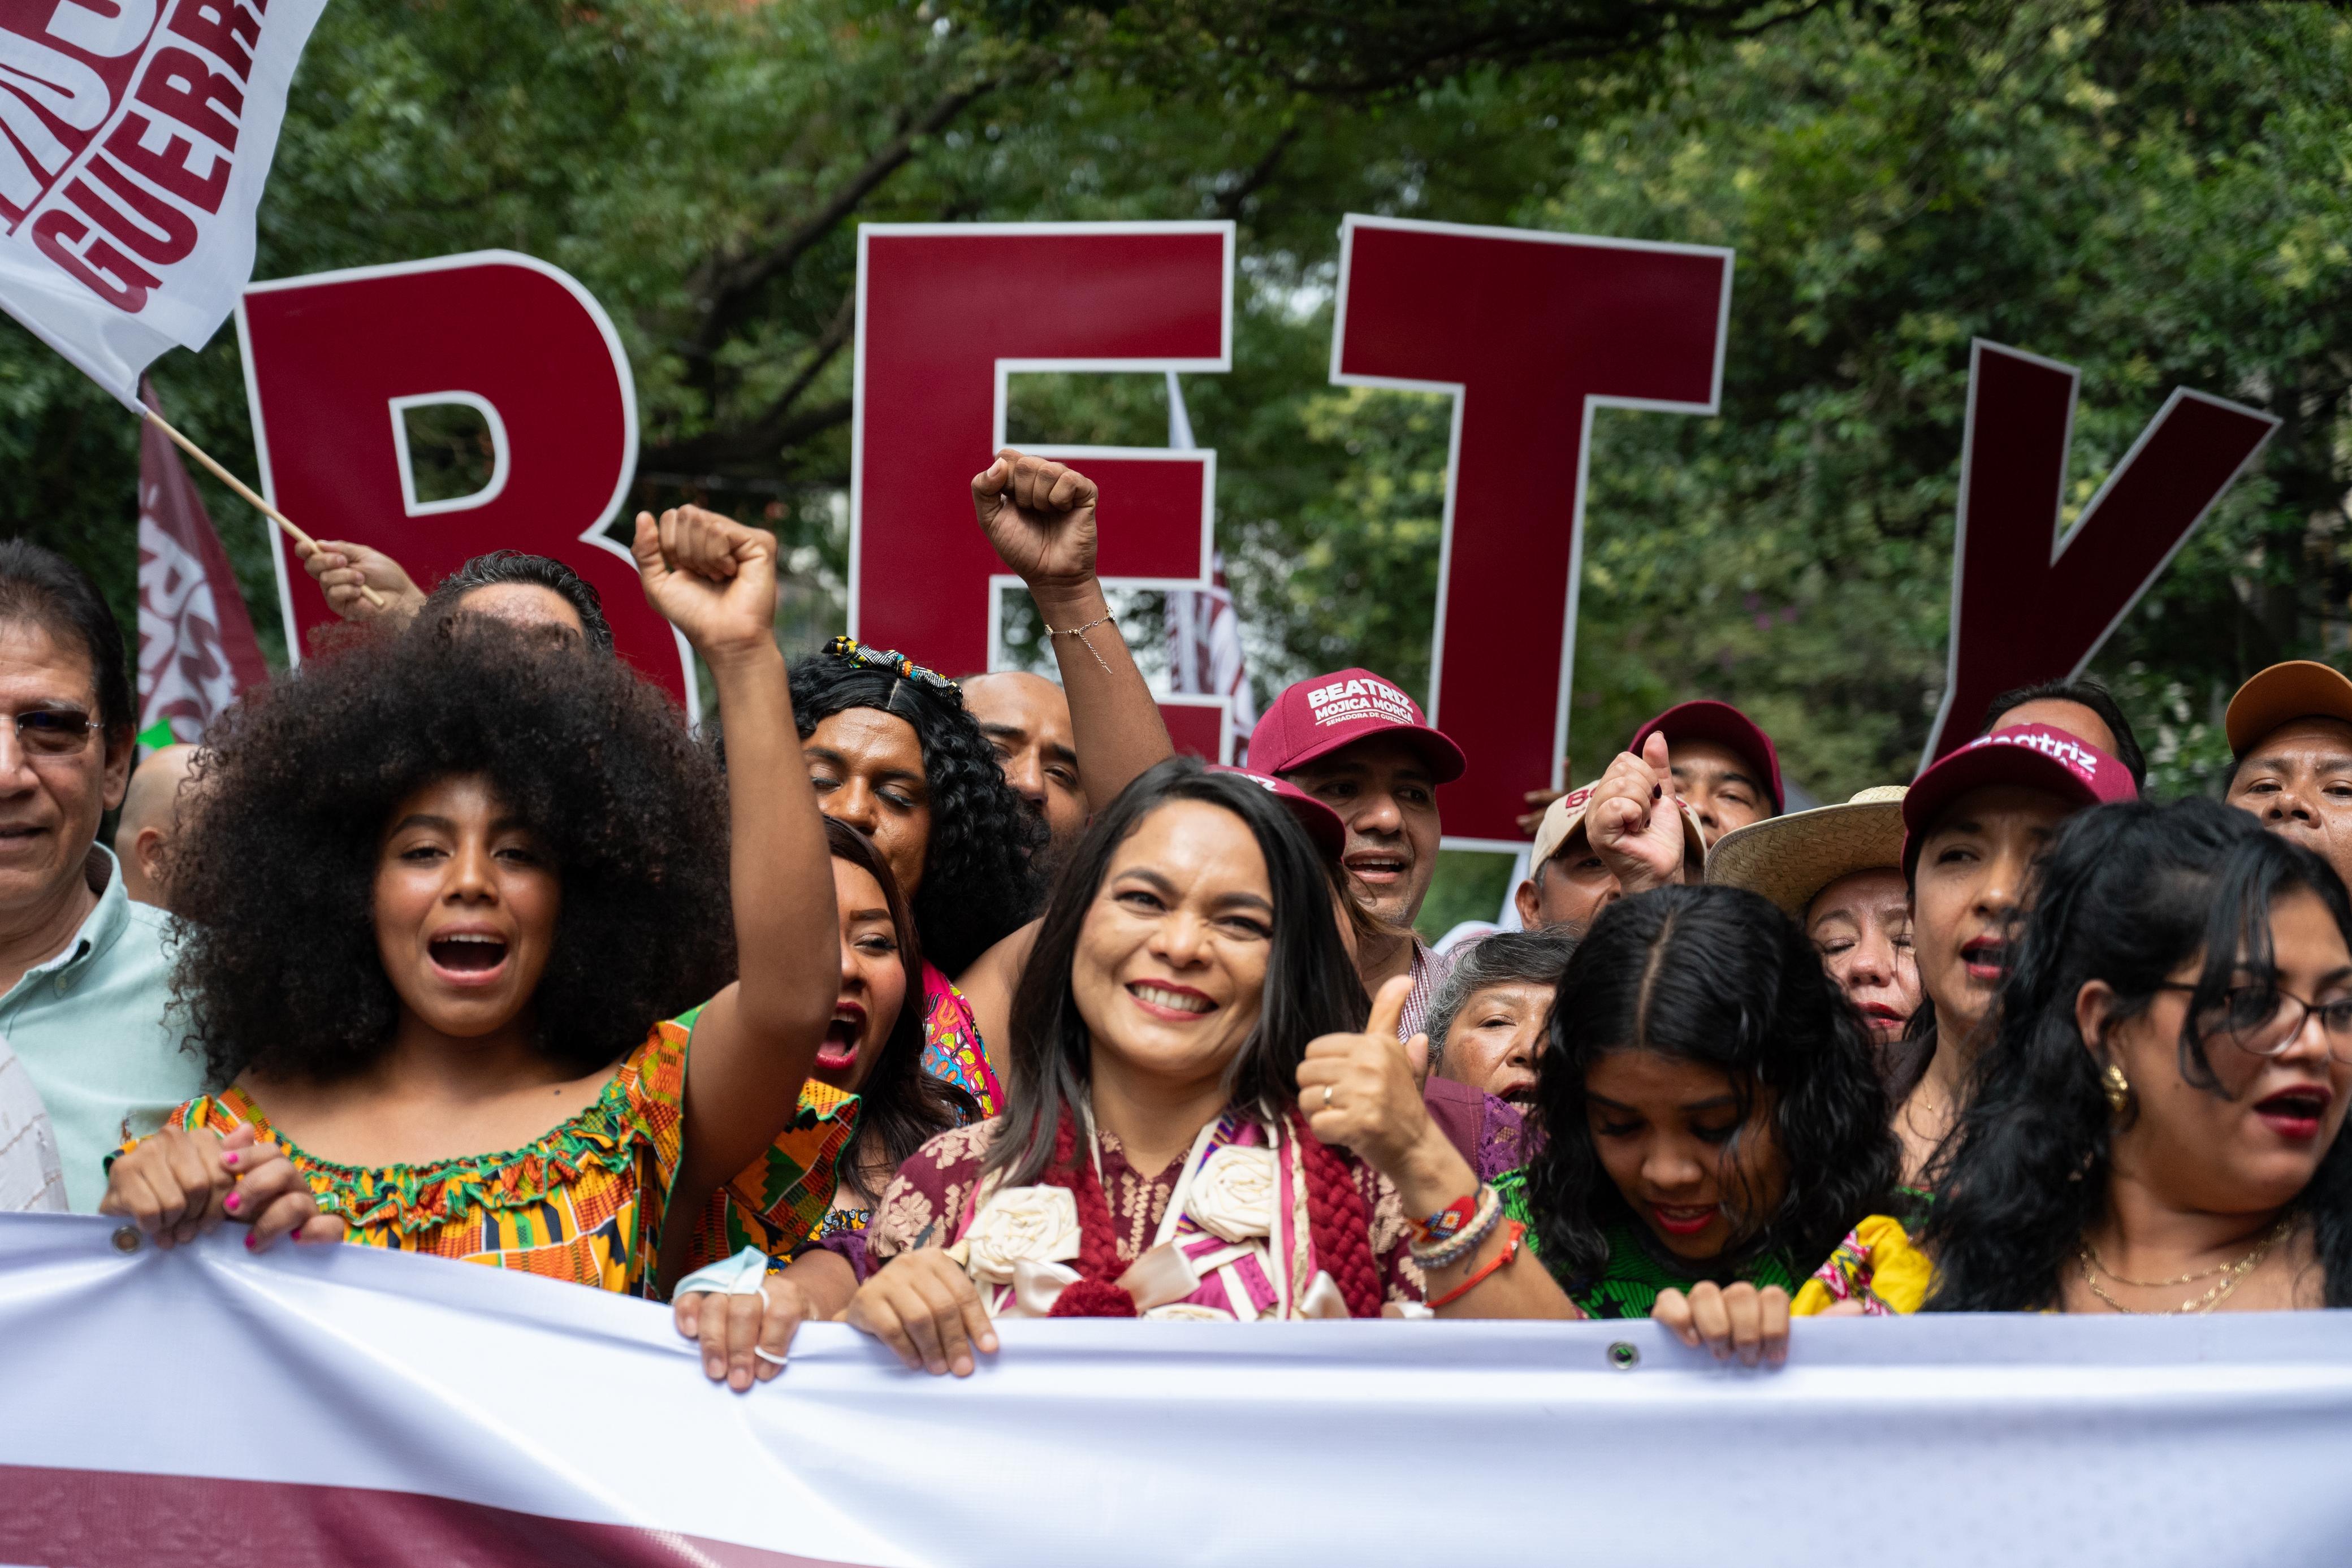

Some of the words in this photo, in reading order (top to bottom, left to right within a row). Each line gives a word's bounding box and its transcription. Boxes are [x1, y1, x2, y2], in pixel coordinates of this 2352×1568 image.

[31, 0, 268, 314] GUERR
[234, 214, 2283, 852] BETY
[1307, 678, 1413, 713] BEATRIZ
[1315, 697, 1371, 720] MOJICA
[1372, 697, 1414, 724] MORGA
[1326, 712, 1368, 726] SENADORA
